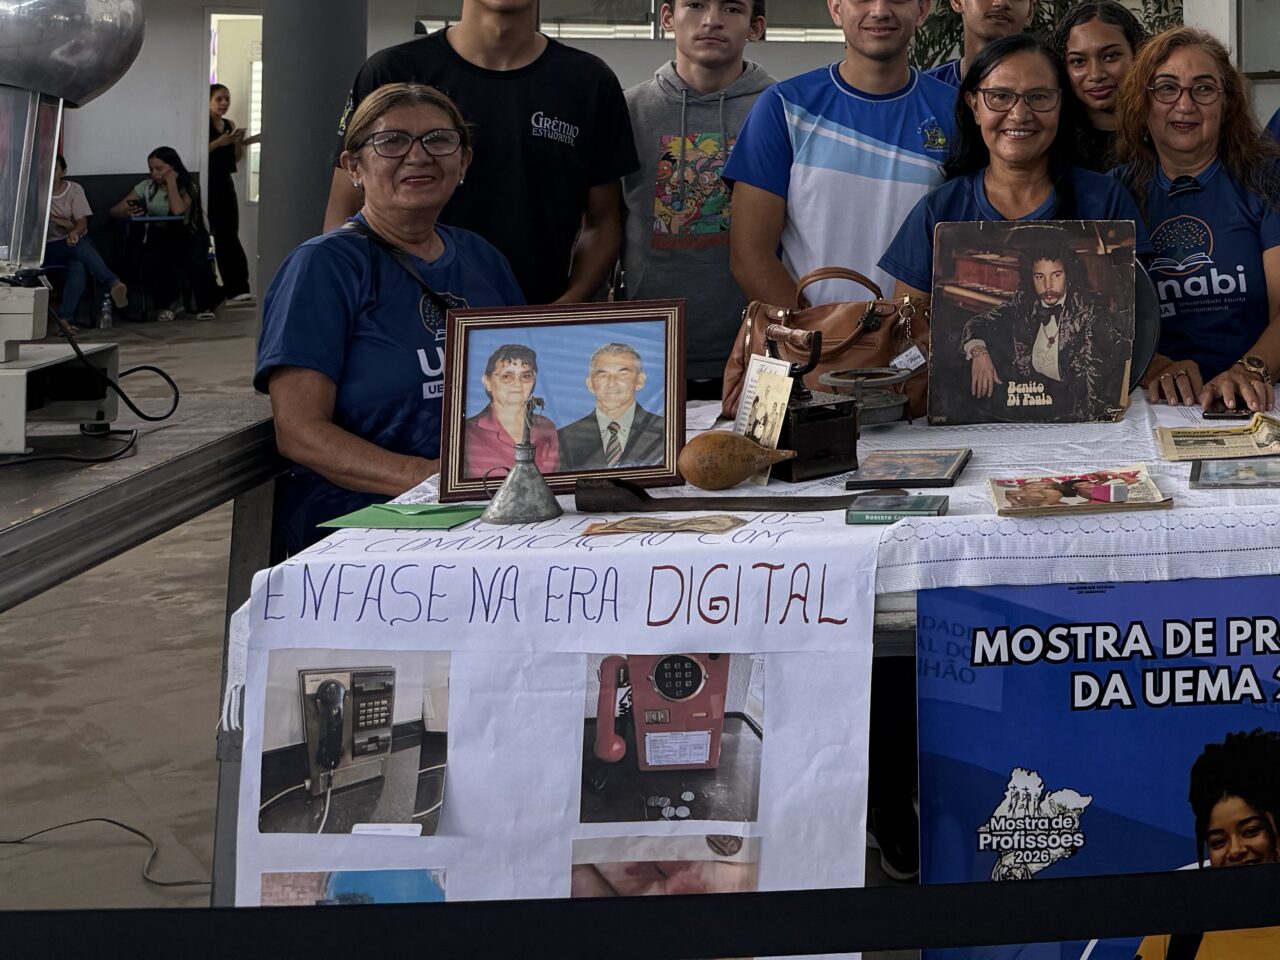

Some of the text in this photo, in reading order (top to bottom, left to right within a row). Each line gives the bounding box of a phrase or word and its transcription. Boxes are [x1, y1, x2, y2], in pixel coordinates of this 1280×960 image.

[1157, 264, 1247, 301] nabi
[428, 384, 444, 394] UE
[1007, 381, 1045, 394] Benito
[1007, 393, 1053, 407] Di Paula
[697, 529, 794, 545] COM
[469, 565, 521, 624] NA
[545, 565, 620, 624] ERA
[646, 562, 849, 627] DIGITAL
[972, 621, 1154, 666] MOSTRA
[1164, 616, 1217, 657] DE
[918, 657, 976, 685] HÃO
[1071, 668, 1134, 711] DA
[1143, 664, 1266, 708] UEMA
[990, 814, 1073, 831] Mostra de
[979, 830, 1085, 851] Profissões
[1015, 850, 1050, 863] 2026
